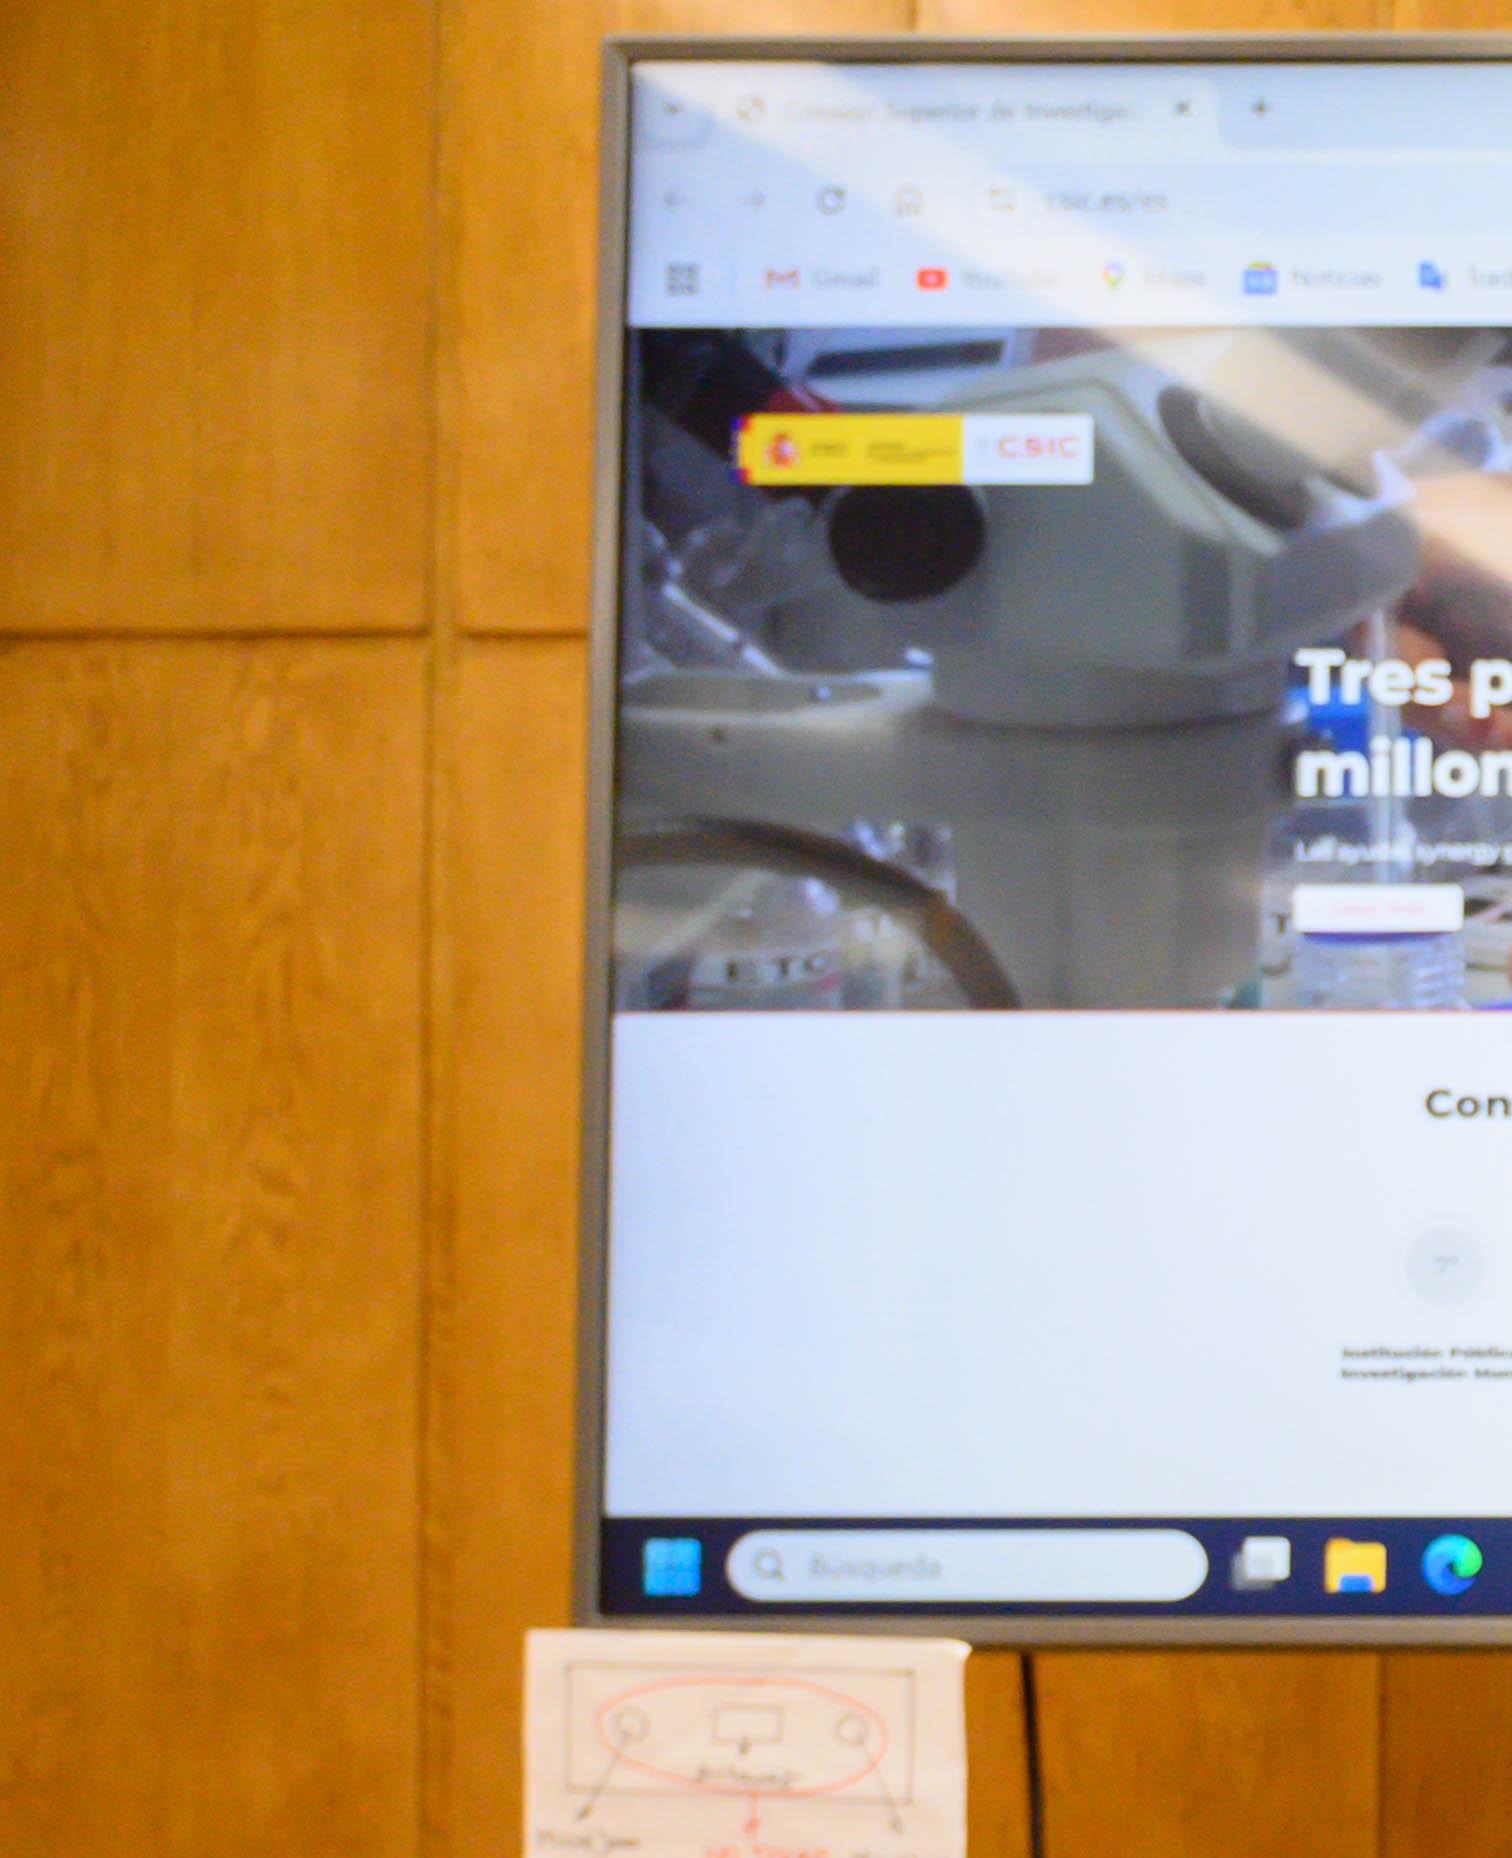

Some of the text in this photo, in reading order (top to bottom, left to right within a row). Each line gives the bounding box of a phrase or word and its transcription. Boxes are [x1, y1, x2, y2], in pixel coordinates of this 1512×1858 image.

[812, 267, 878, 289] Gmail
[1292, 267, 1382, 289] Noticias
[998, 436, 1079, 460] CSIC
[1295, 648, 1452, 705] Tres
[810, 1555, 942, 1582] Búsqueda
